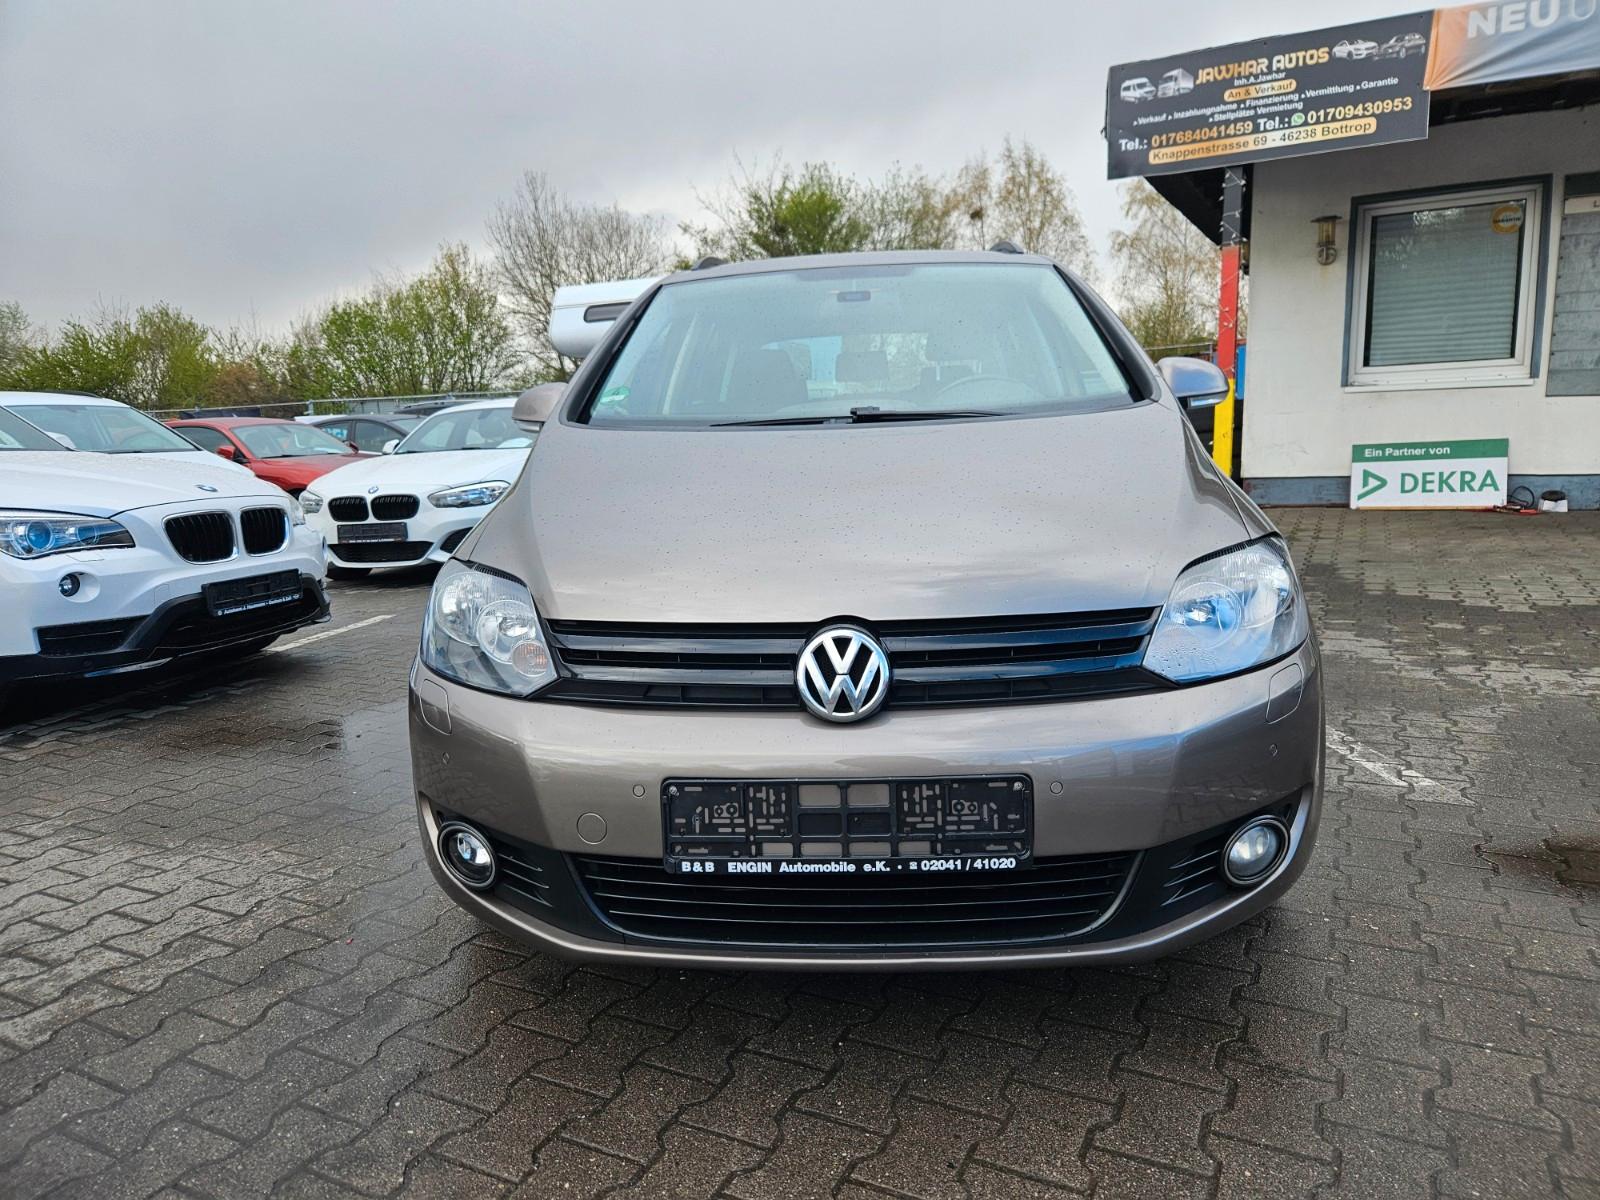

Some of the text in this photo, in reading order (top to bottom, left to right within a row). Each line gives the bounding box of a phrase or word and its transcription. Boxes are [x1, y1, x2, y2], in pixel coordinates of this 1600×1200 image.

[1195, 47, 1330, 85] JAWHAR AUTOS
[1227, 81, 1293, 99] An & Verkauf
[1245, 92, 1299, 108] Finanzierung
[1305, 84, 1355, 99] Vermittlung
[1361, 77, 1399, 90] Garantie
[1256, 101, 1304, 116] Vermietung
[1119, 96, 1413, 152] Tel.: 017684041459 Tel.: 01709430953
[1152, 141, 1249, 162] Knappenstrasse
[1253, 136, 1268, 146] 69
[1279, 127, 1317, 143] 46238
[1321, 122, 1372, 138] Bottrop
[1364, 446, 1450, 458] Ein Partner von
[1400, 469, 1500, 494] DEKRA
[797, 628, 889, 717] VW
[727, 861, 772, 873] ENGIN
[779, 861, 856, 873] Automobile
[863, 860, 891, 872] e.K.
